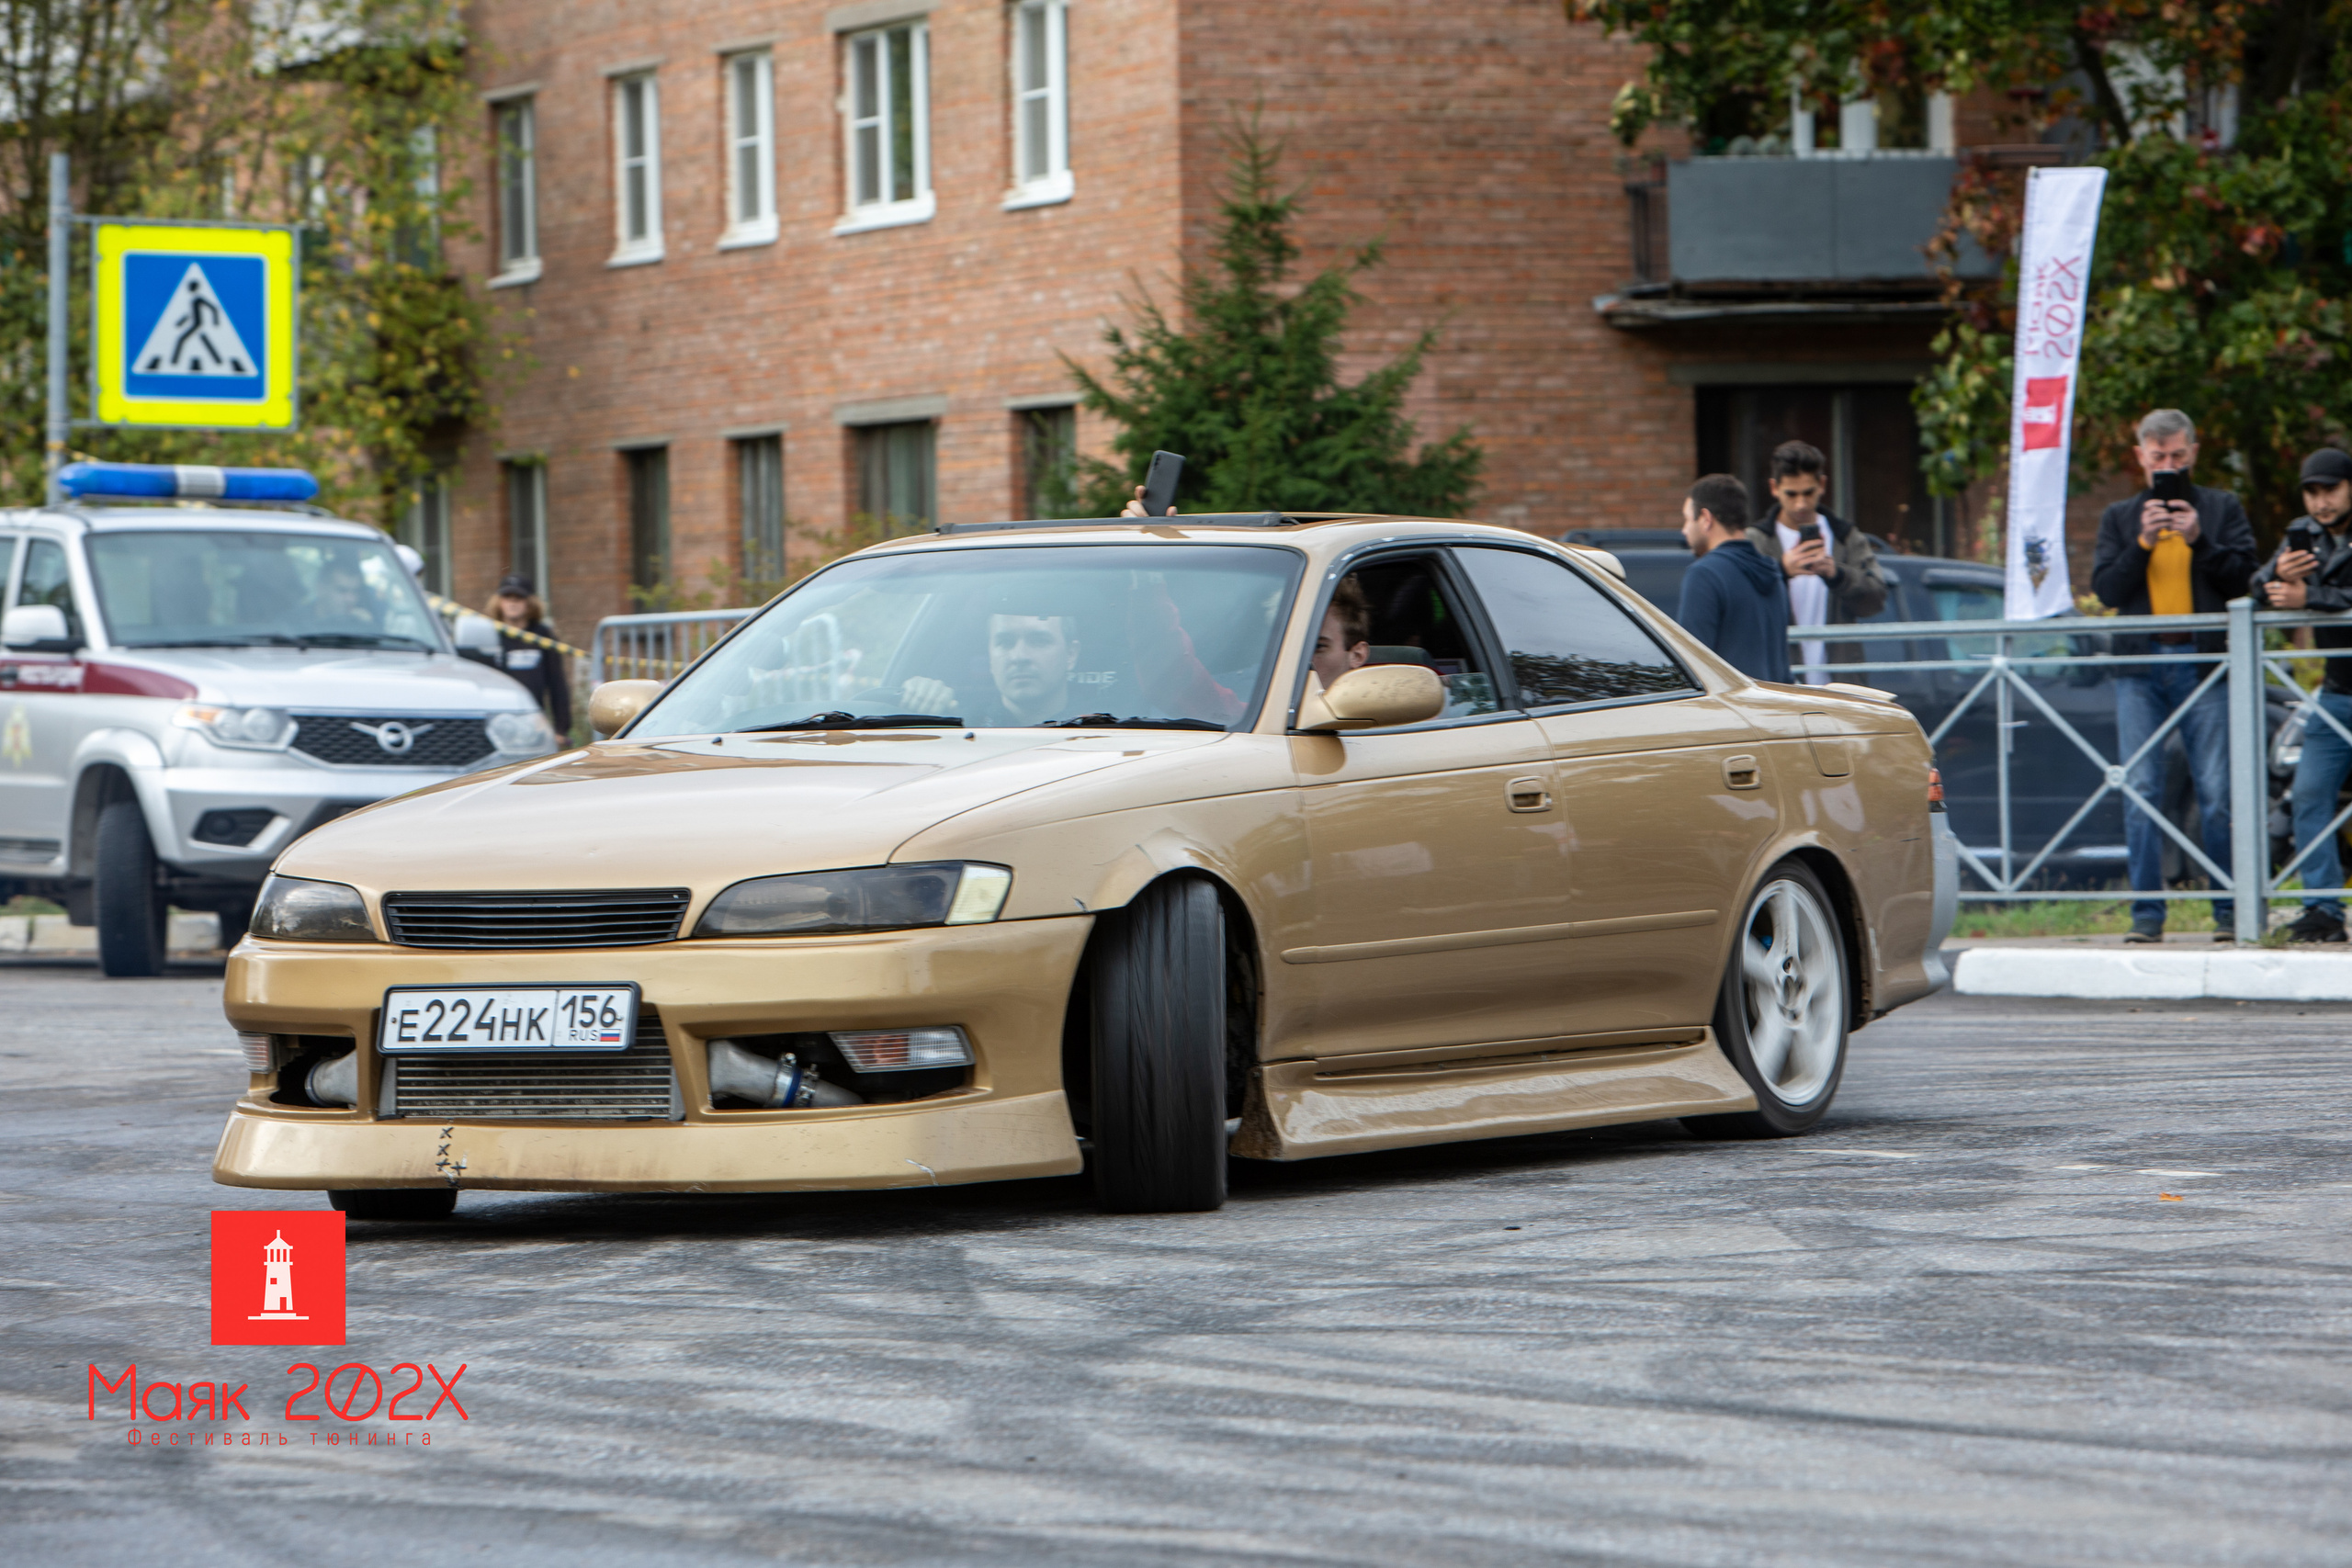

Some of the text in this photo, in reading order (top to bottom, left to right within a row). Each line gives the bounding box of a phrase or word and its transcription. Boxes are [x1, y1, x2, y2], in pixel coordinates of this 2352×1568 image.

[398, 995, 616, 1042] Е224НК 156
[568, 1030, 598, 1041] RUS
